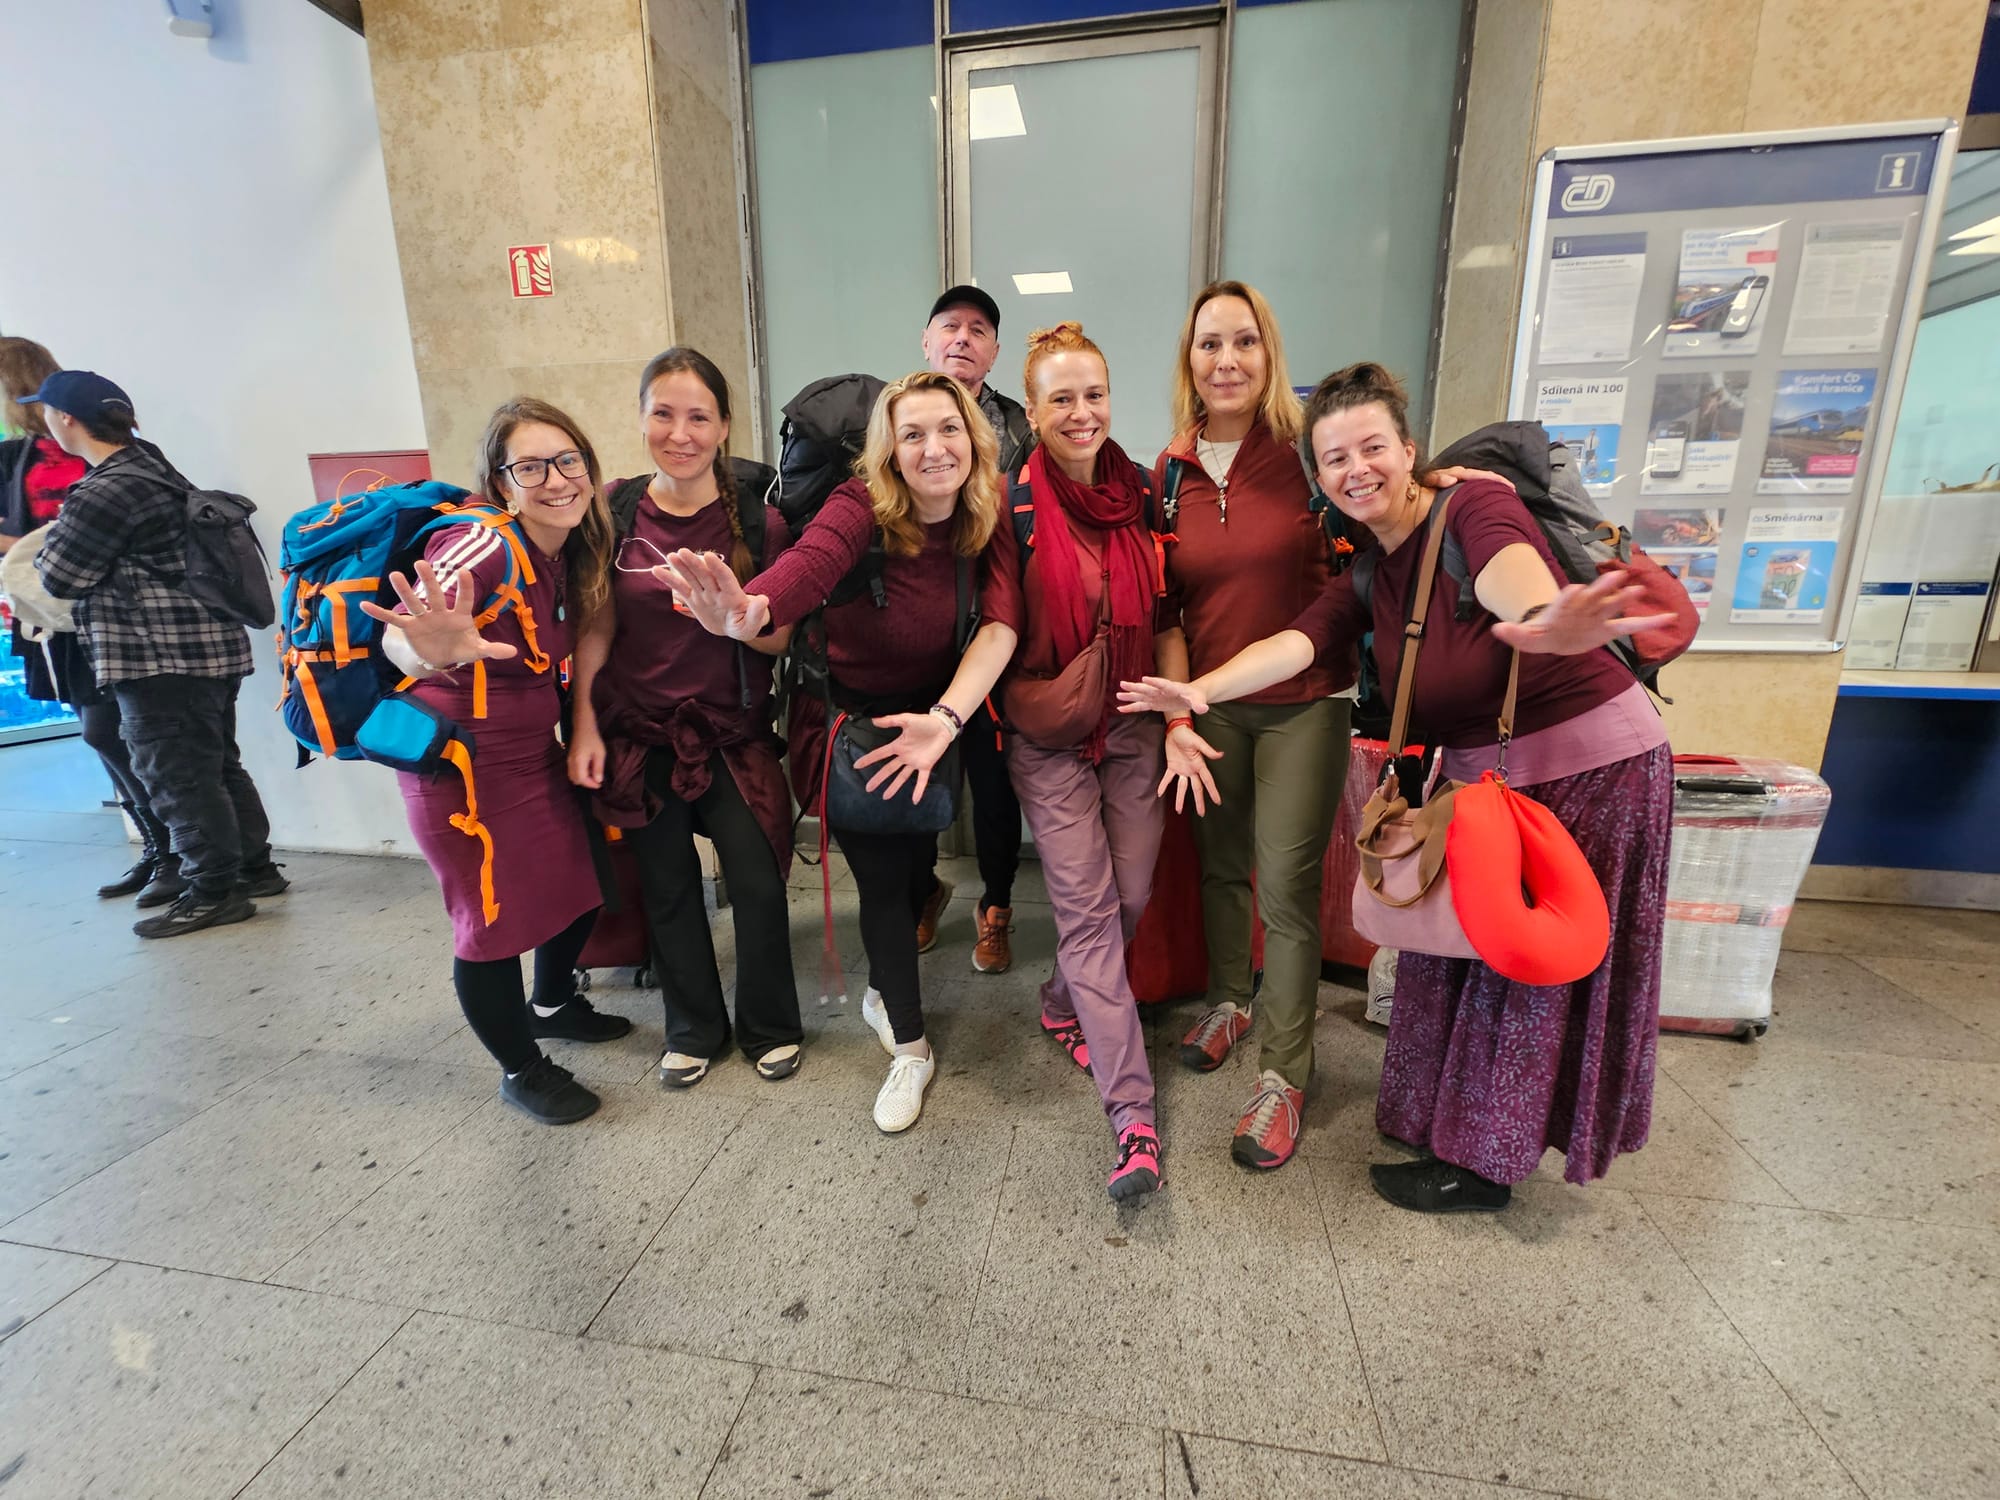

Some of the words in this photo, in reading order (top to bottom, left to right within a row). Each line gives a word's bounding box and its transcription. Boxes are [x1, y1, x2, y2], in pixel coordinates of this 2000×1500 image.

[1794, 374, 1841, 385] Komfort
[1843, 371, 1861, 384] ČD
[1541, 384, 1584, 396] Sdílená
[1586, 384, 1600, 394] IN
[1603, 383, 1624, 393] 100
[1821, 383, 1865, 394] hranice
[1764, 512, 1824, 523] Směnárna
